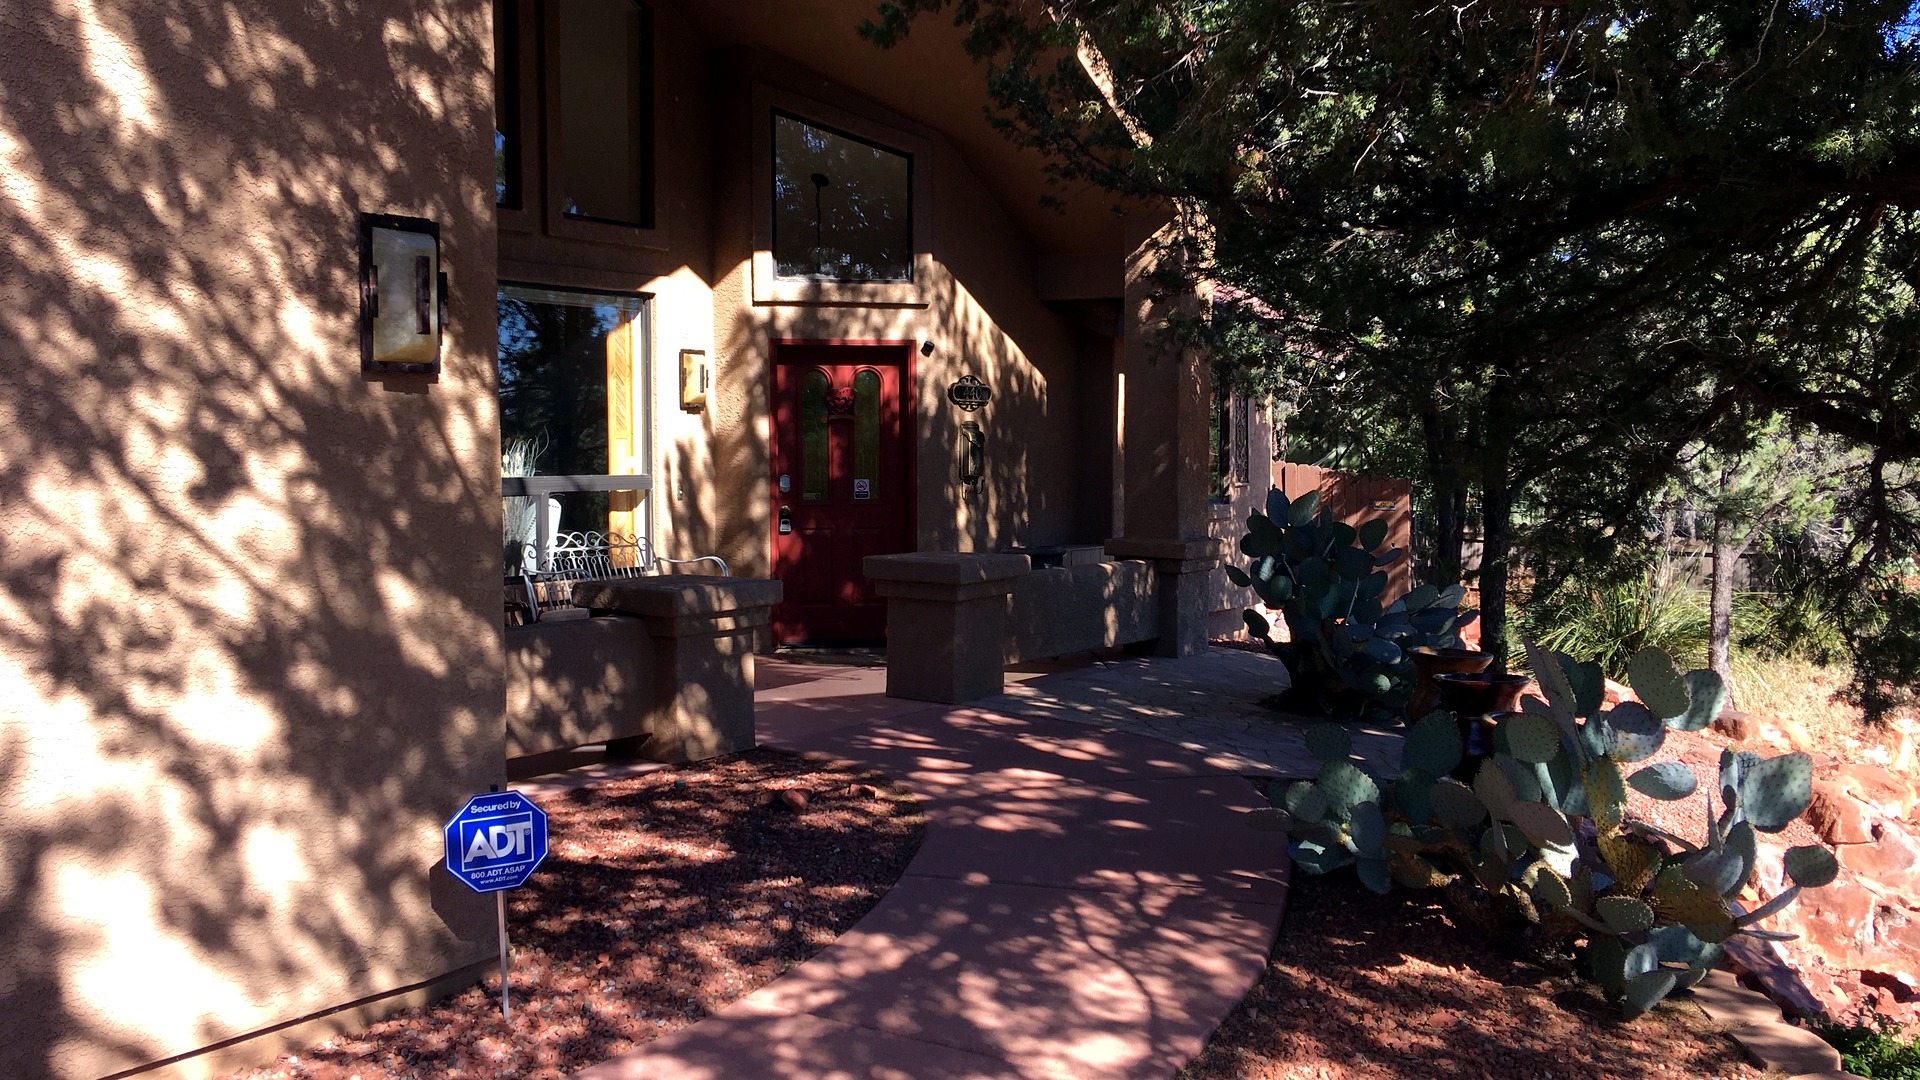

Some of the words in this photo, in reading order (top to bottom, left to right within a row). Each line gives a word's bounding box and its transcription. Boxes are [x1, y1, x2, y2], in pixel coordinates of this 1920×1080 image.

[470, 801, 509, 814] Secured
[510, 800, 521, 810] by
[464, 821, 531, 863] ADT
[471, 865, 526, 879] 800.ADT.ASAP
[480, 875, 518, 885] www.ADT.com
